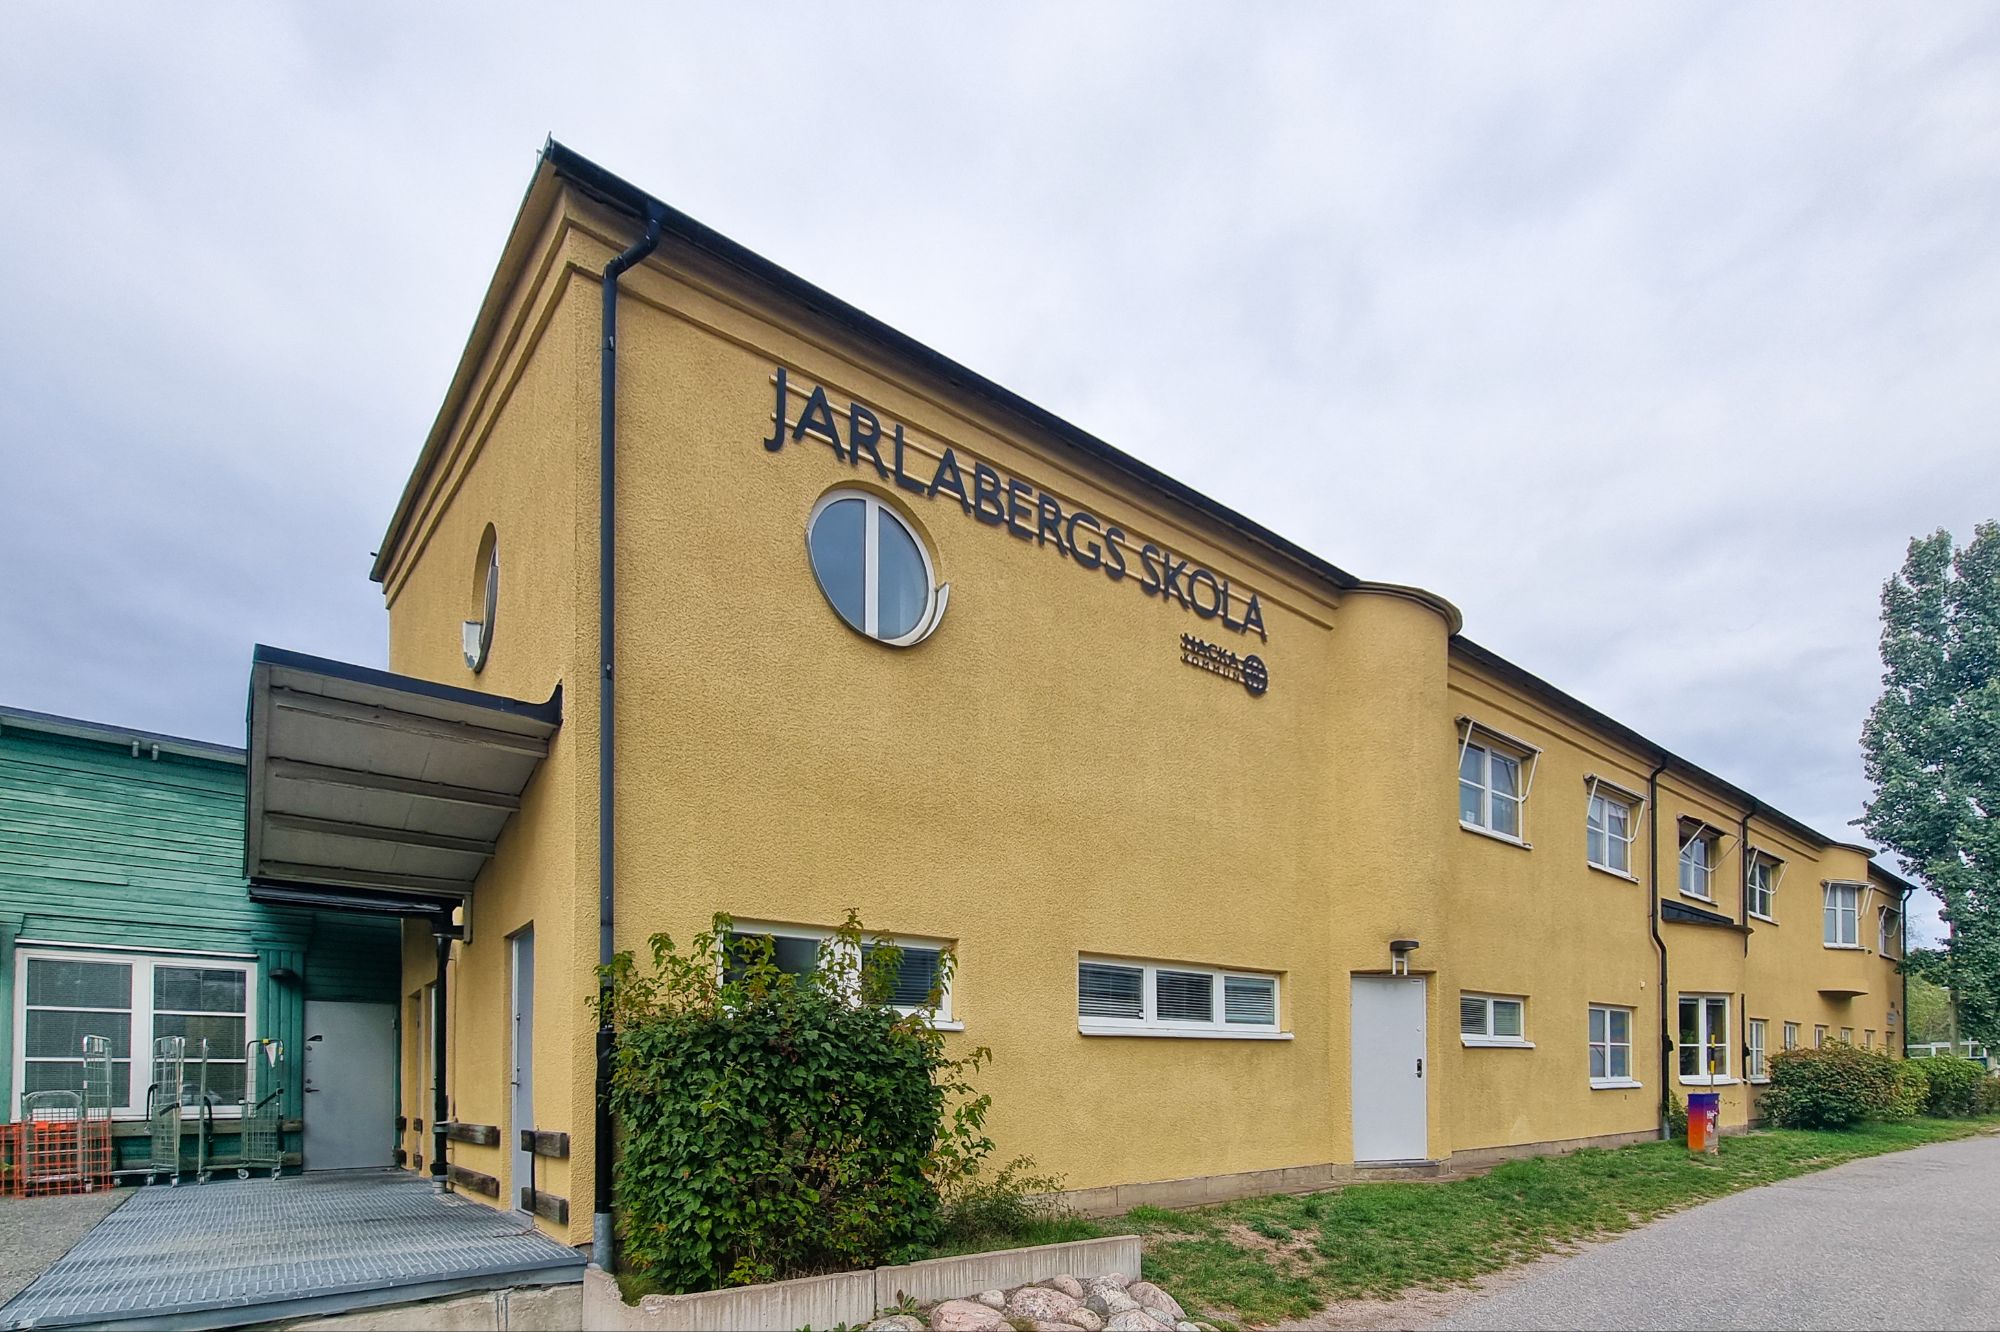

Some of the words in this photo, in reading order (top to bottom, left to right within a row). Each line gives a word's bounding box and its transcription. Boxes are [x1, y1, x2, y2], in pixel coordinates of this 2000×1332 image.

[763, 367, 1127, 581] JARLABERGS
[1141, 543, 1269, 643] SKOLA
[1183, 633, 1239, 668] NACKA
